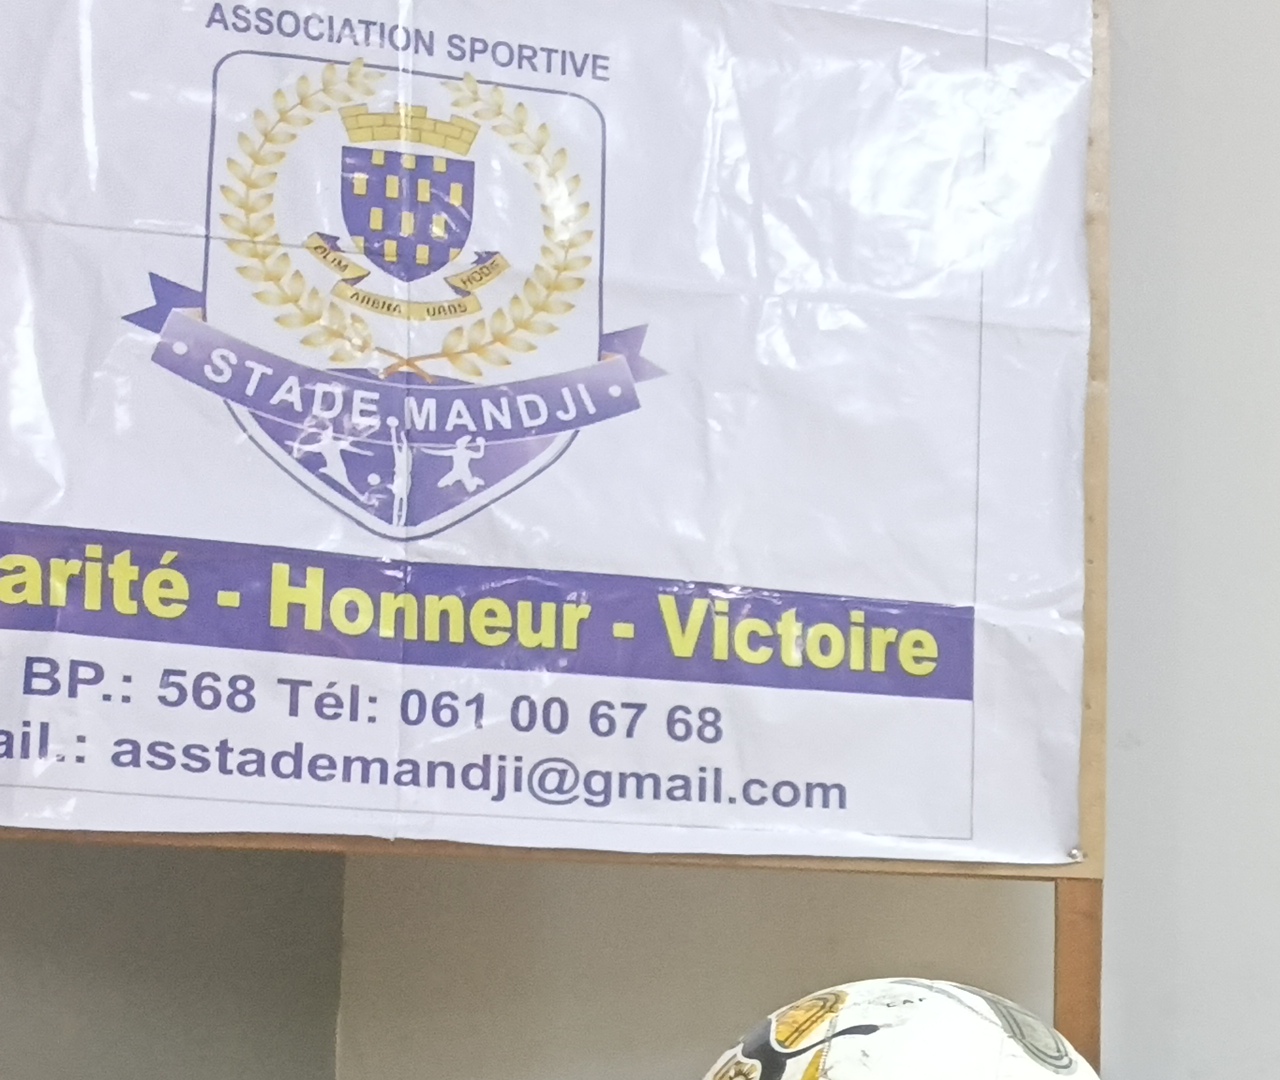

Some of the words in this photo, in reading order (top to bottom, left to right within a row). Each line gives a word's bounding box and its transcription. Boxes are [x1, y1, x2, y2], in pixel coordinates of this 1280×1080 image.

[205, 3, 435, 57] ASSOCIATION
[446, 33, 610, 82] SPORTIVE
[203, 349, 381, 429] STADE
[404, 382, 597, 432] MANDJI
[269, 562, 590, 650] Honneur
[658, 594, 939, 677] Victoire
[23, 656, 132, 703] BP.:
[157, 668, 256, 713] 568
[277, 676, 378, 724] Tél:
[400, 687, 485, 730] 061
[510, 695, 569, 737] 00
[590, 701, 648, 740] 67
[666, 704, 724, 744] 68
[111, 734, 848, 811] asstademandji@gmail.com
